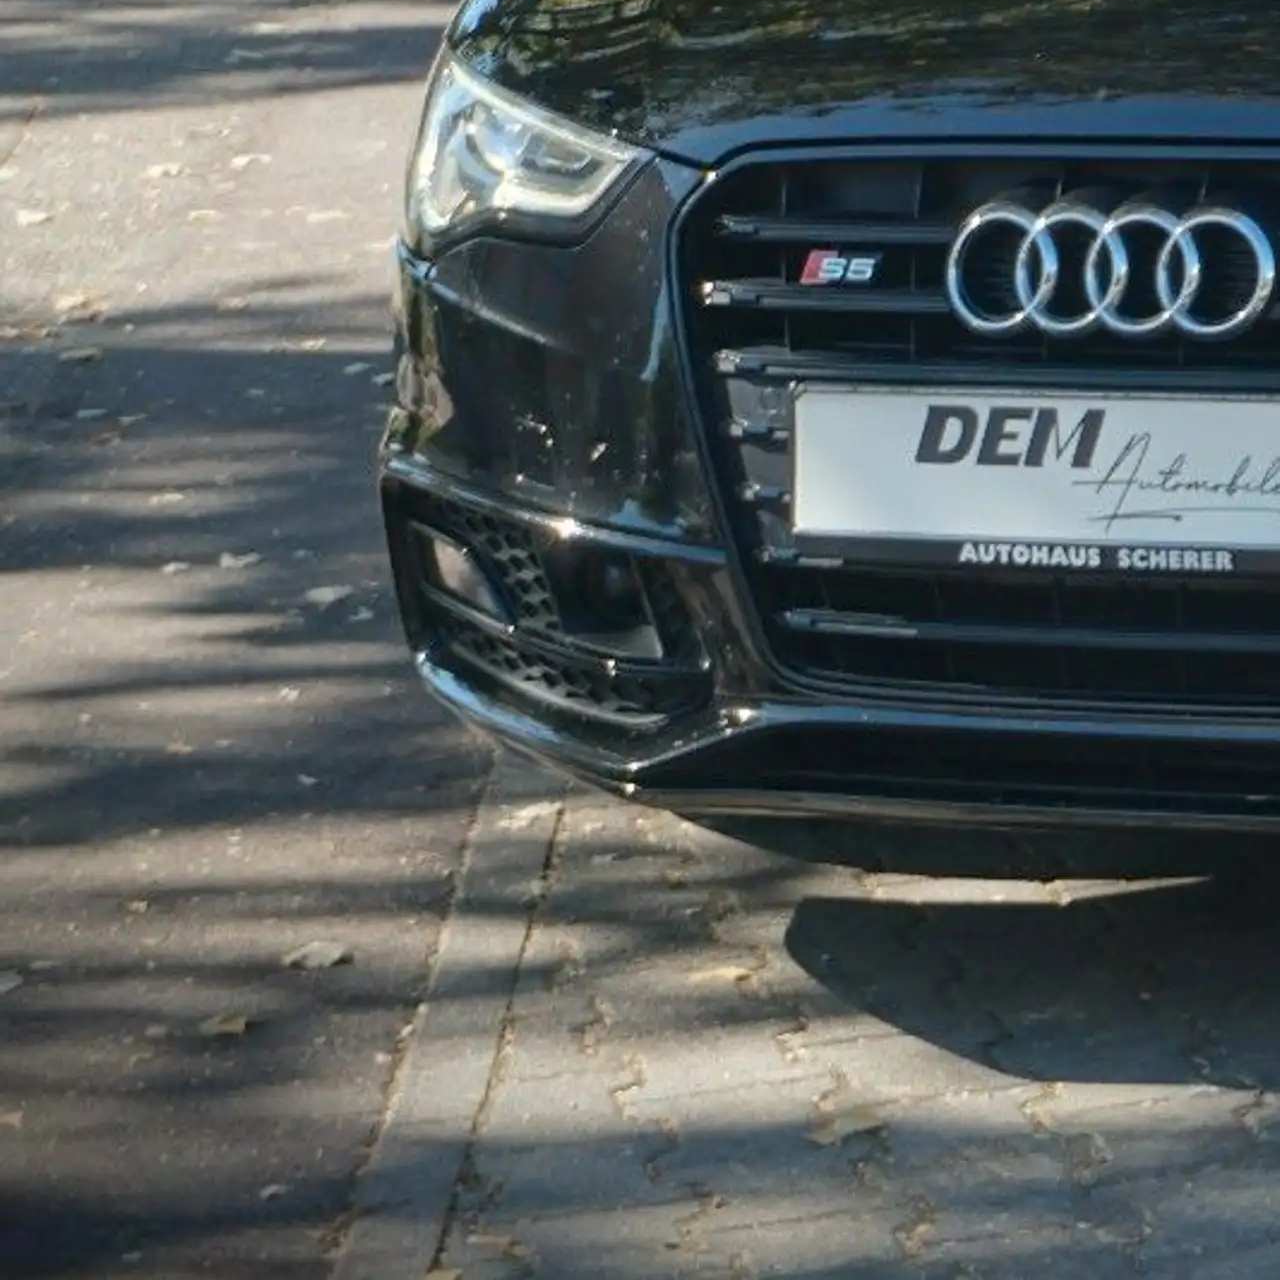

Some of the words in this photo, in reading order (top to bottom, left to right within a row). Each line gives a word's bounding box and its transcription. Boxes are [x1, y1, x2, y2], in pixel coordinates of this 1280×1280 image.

[914, 405, 1106, 468] DEM
[958, 542, 1101, 568] AUTOHAUS
[1117, 547, 1235, 571] SCHERER
